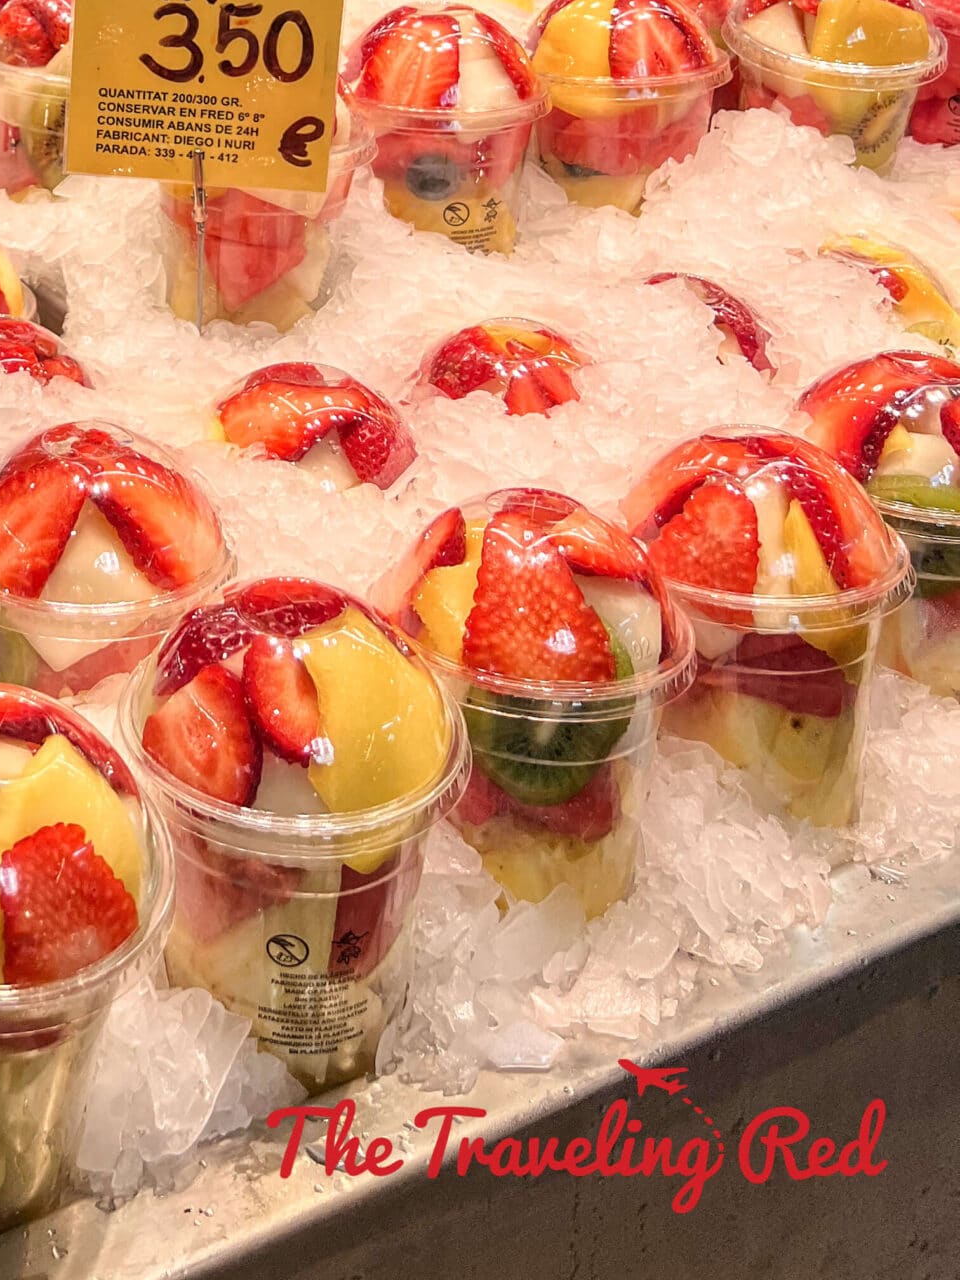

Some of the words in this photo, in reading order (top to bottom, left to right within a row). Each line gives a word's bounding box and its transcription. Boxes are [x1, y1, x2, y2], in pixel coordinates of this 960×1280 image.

[98, 87, 169, 102] QUANTITAT
[171, 92, 218, 106] 200/300
[221, 96, 243, 108] GR.
[97, 101, 176, 117] CONSERVAR
[179, 107, 197, 118] EN
[200, 109, 234, 122] FRED
[97, 115, 164, 130] CONSUMIR
[167, 121, 212, 133] ABANS
[215, 124, 233, 135] DE
[236, 126, 259, 137] 24H
[96, 129, 171, 144] FABRICANT:
[173, 135, 214, 148] DIEGO
[224, 138, 255, 151] NURI
[95, 143, 151, 157] PARADA:
[154, 148, 176, 159] 339
[186, 150, 206, 161] 41
[217, 152, 239, 163] 412
